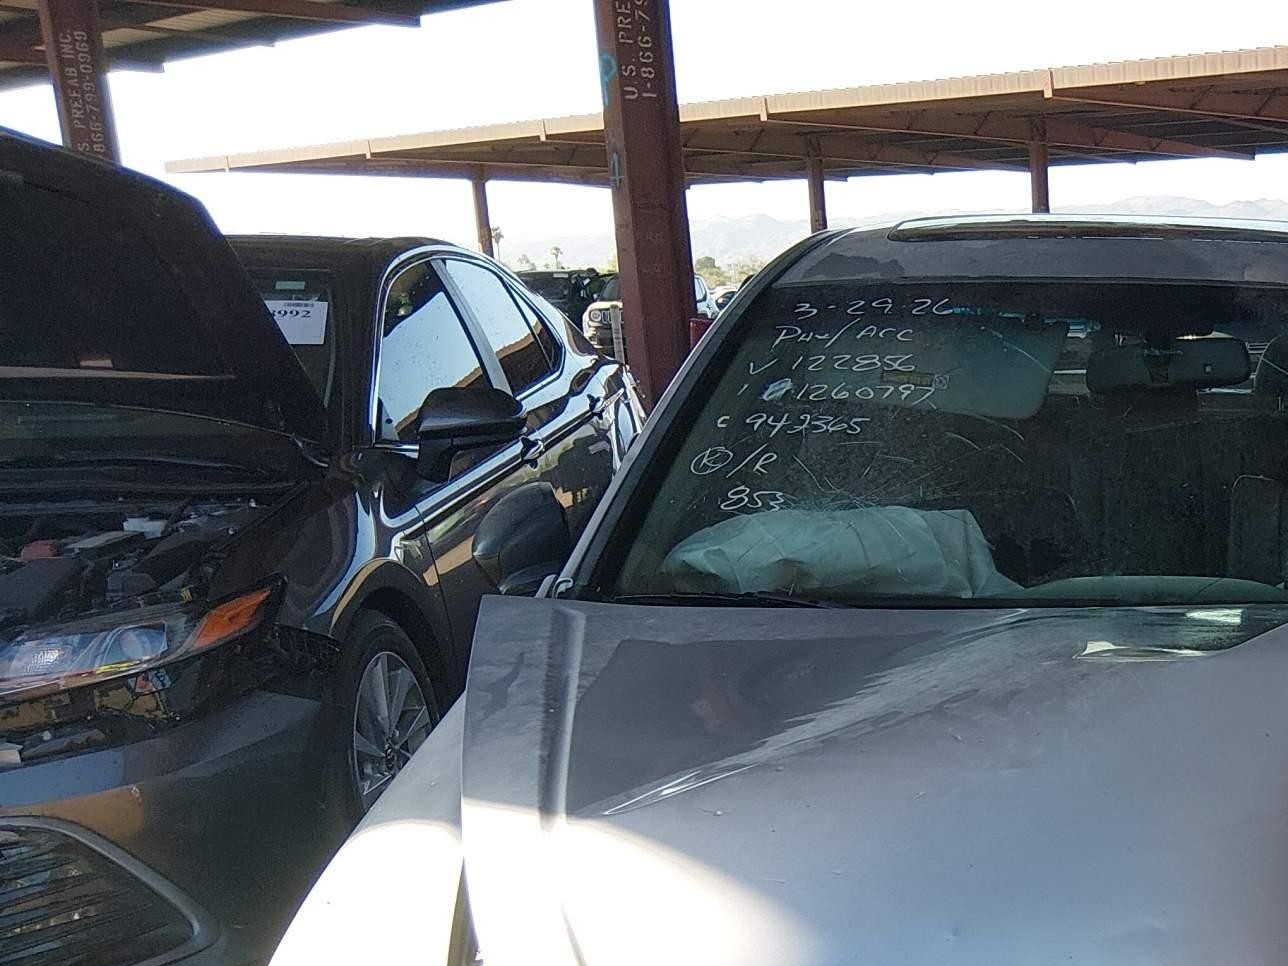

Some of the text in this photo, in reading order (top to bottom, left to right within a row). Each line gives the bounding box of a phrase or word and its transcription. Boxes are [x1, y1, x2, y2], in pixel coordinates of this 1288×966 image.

[60, 30, 75, 59] INC.
[621, 58, 639, 99] U.S.
[64, 67, 87, 129] PREFAB
[792, 354, 915, 371] 122856
